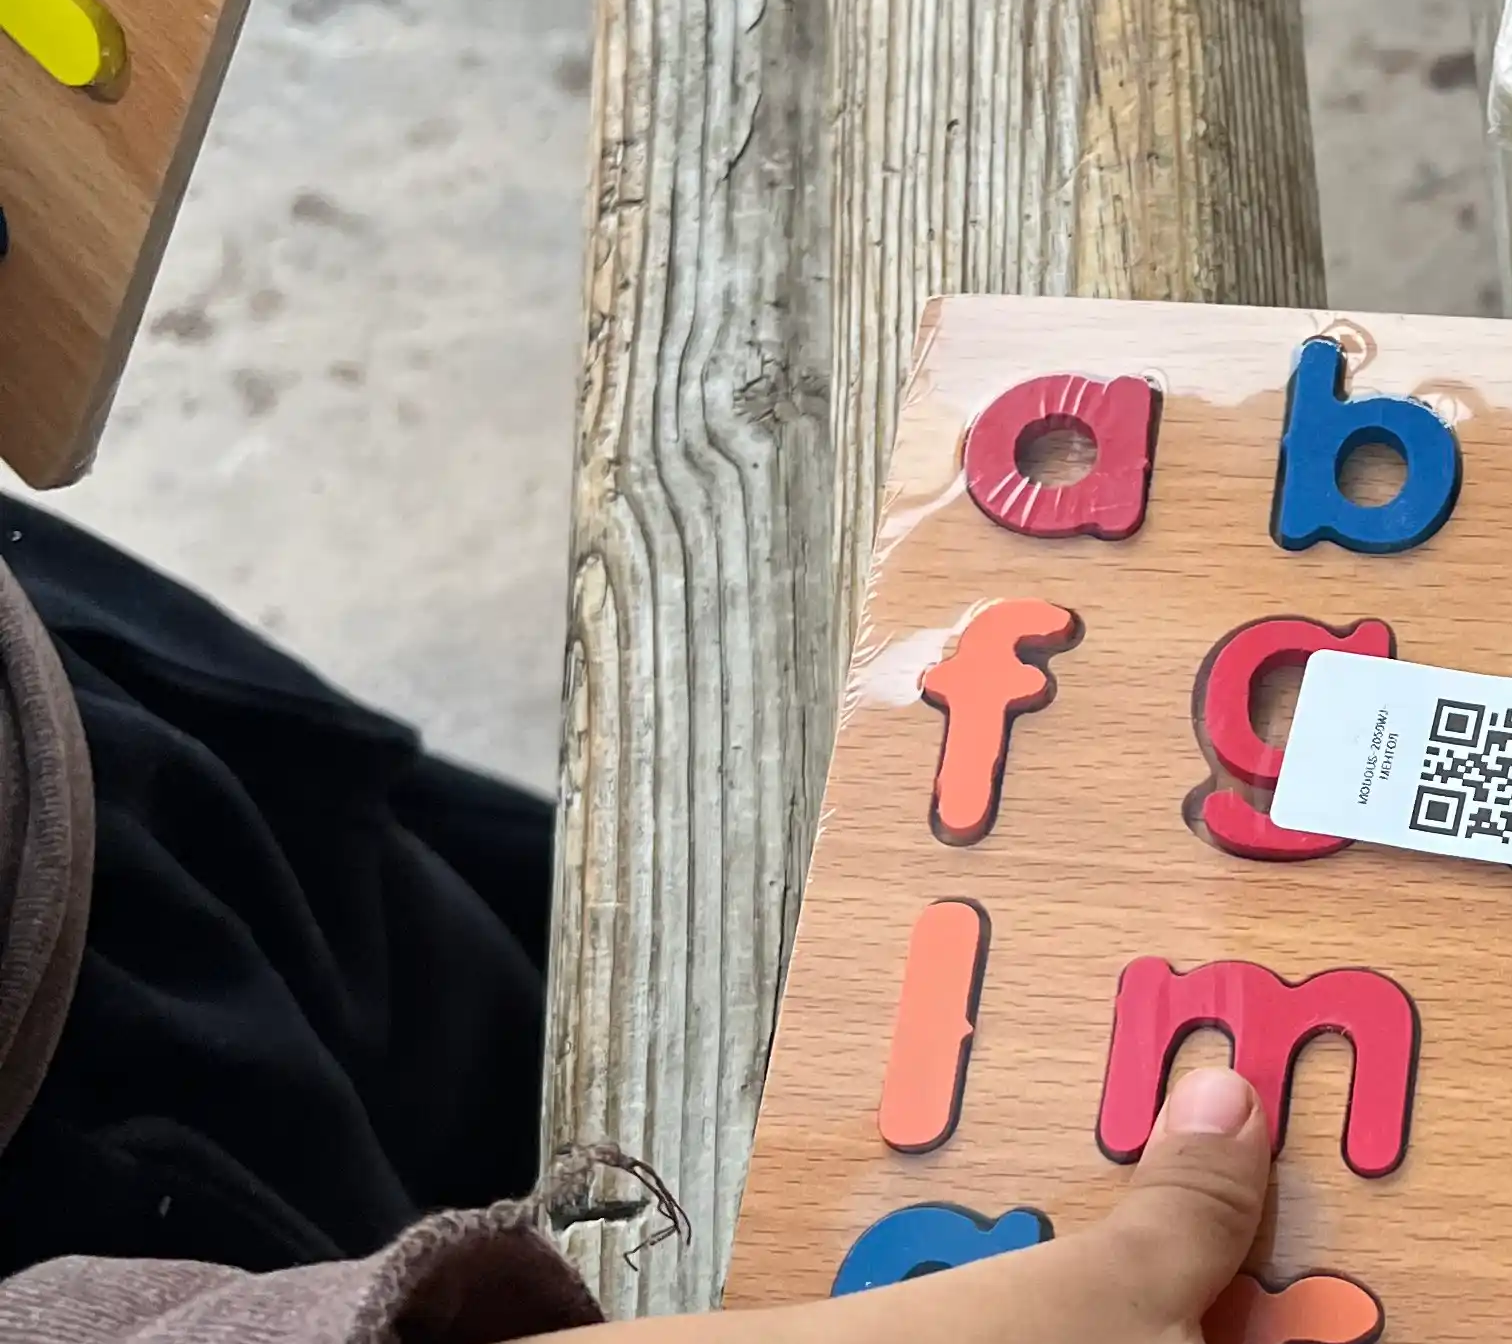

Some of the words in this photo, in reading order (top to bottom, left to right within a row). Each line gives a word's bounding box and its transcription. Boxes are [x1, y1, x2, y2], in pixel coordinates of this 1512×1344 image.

[964, 376, 1159, 539] a
[1272, 336, 1462, 552] b
[920, 601, 1080, 846] f
[1200, 616, 1397, 860] g
[1097, 956, 1421, 1176] m
